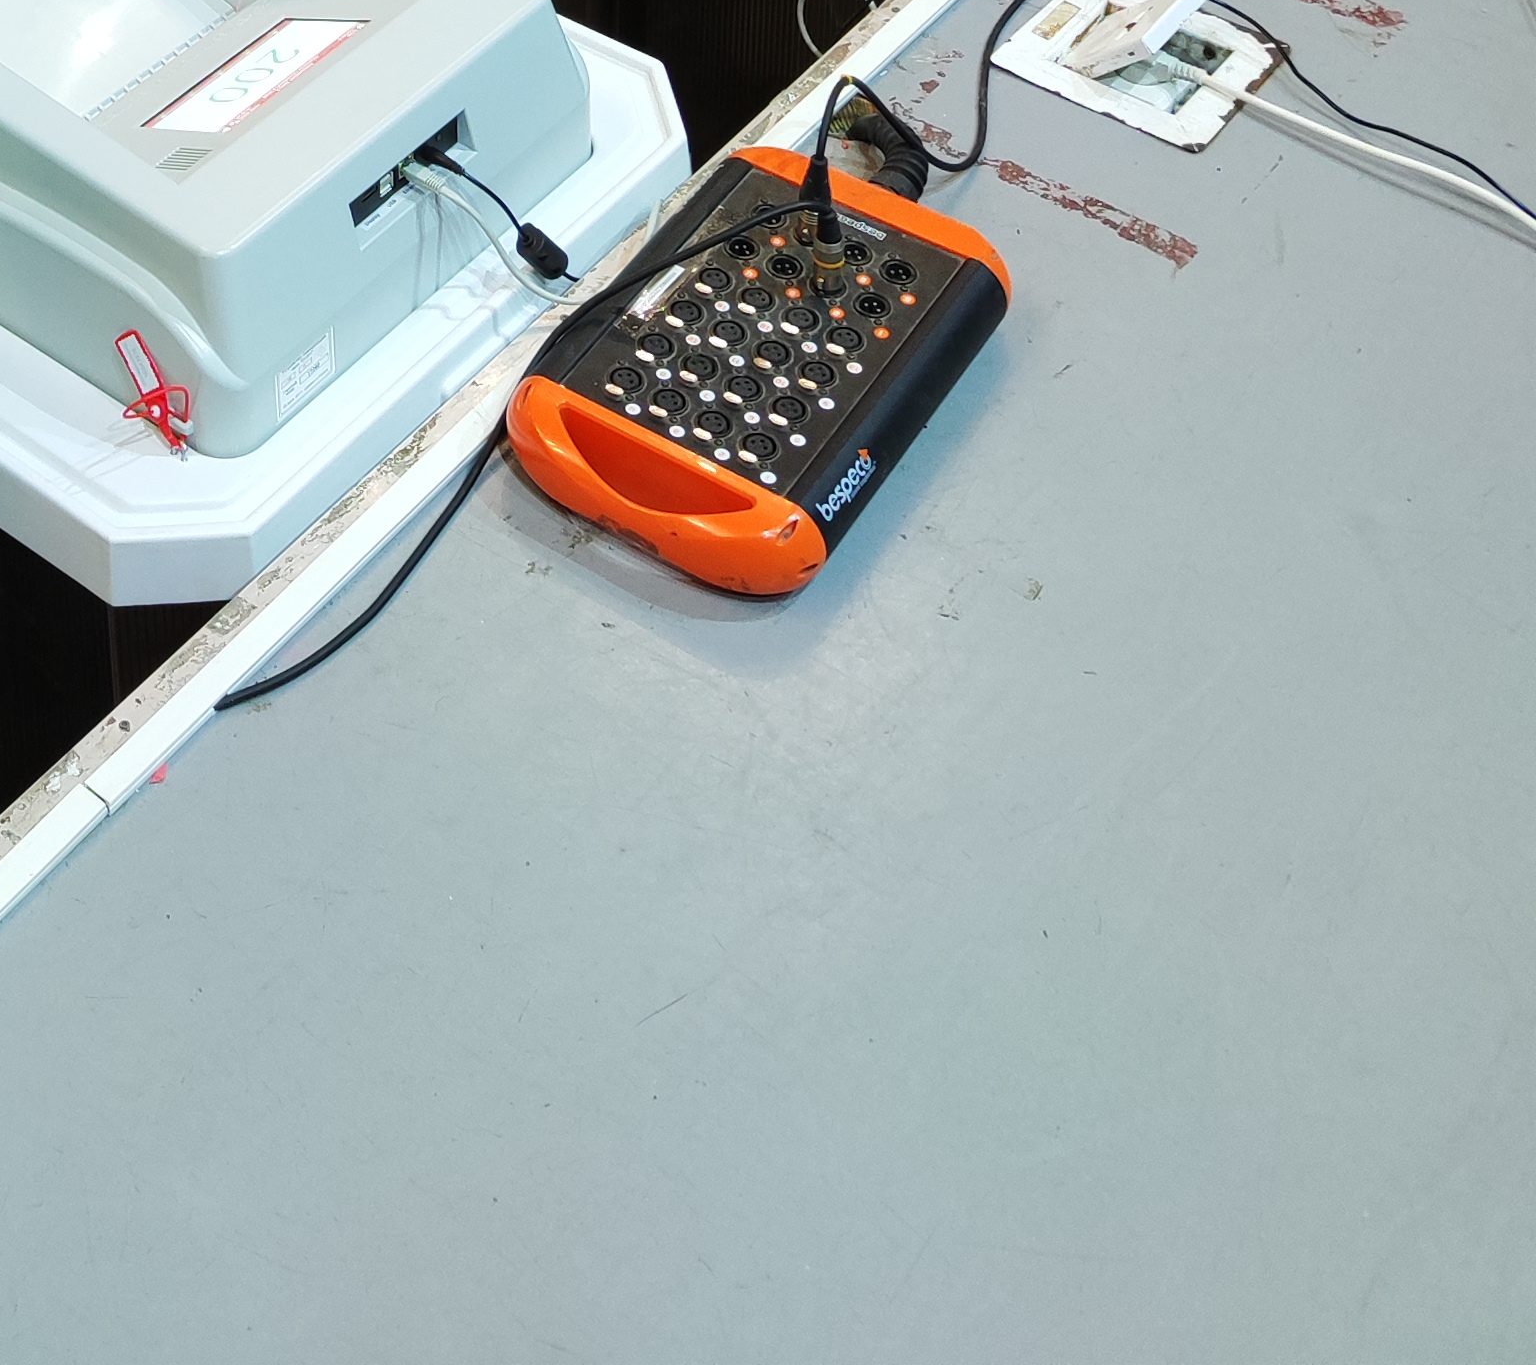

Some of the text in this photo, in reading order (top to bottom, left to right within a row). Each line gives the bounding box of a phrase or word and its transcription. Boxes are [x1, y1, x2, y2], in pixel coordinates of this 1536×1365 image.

[209, 48, 300, 103] 200
[836, 213, 886, 240] bespec
[815, 449, 872, 522] bespeco
